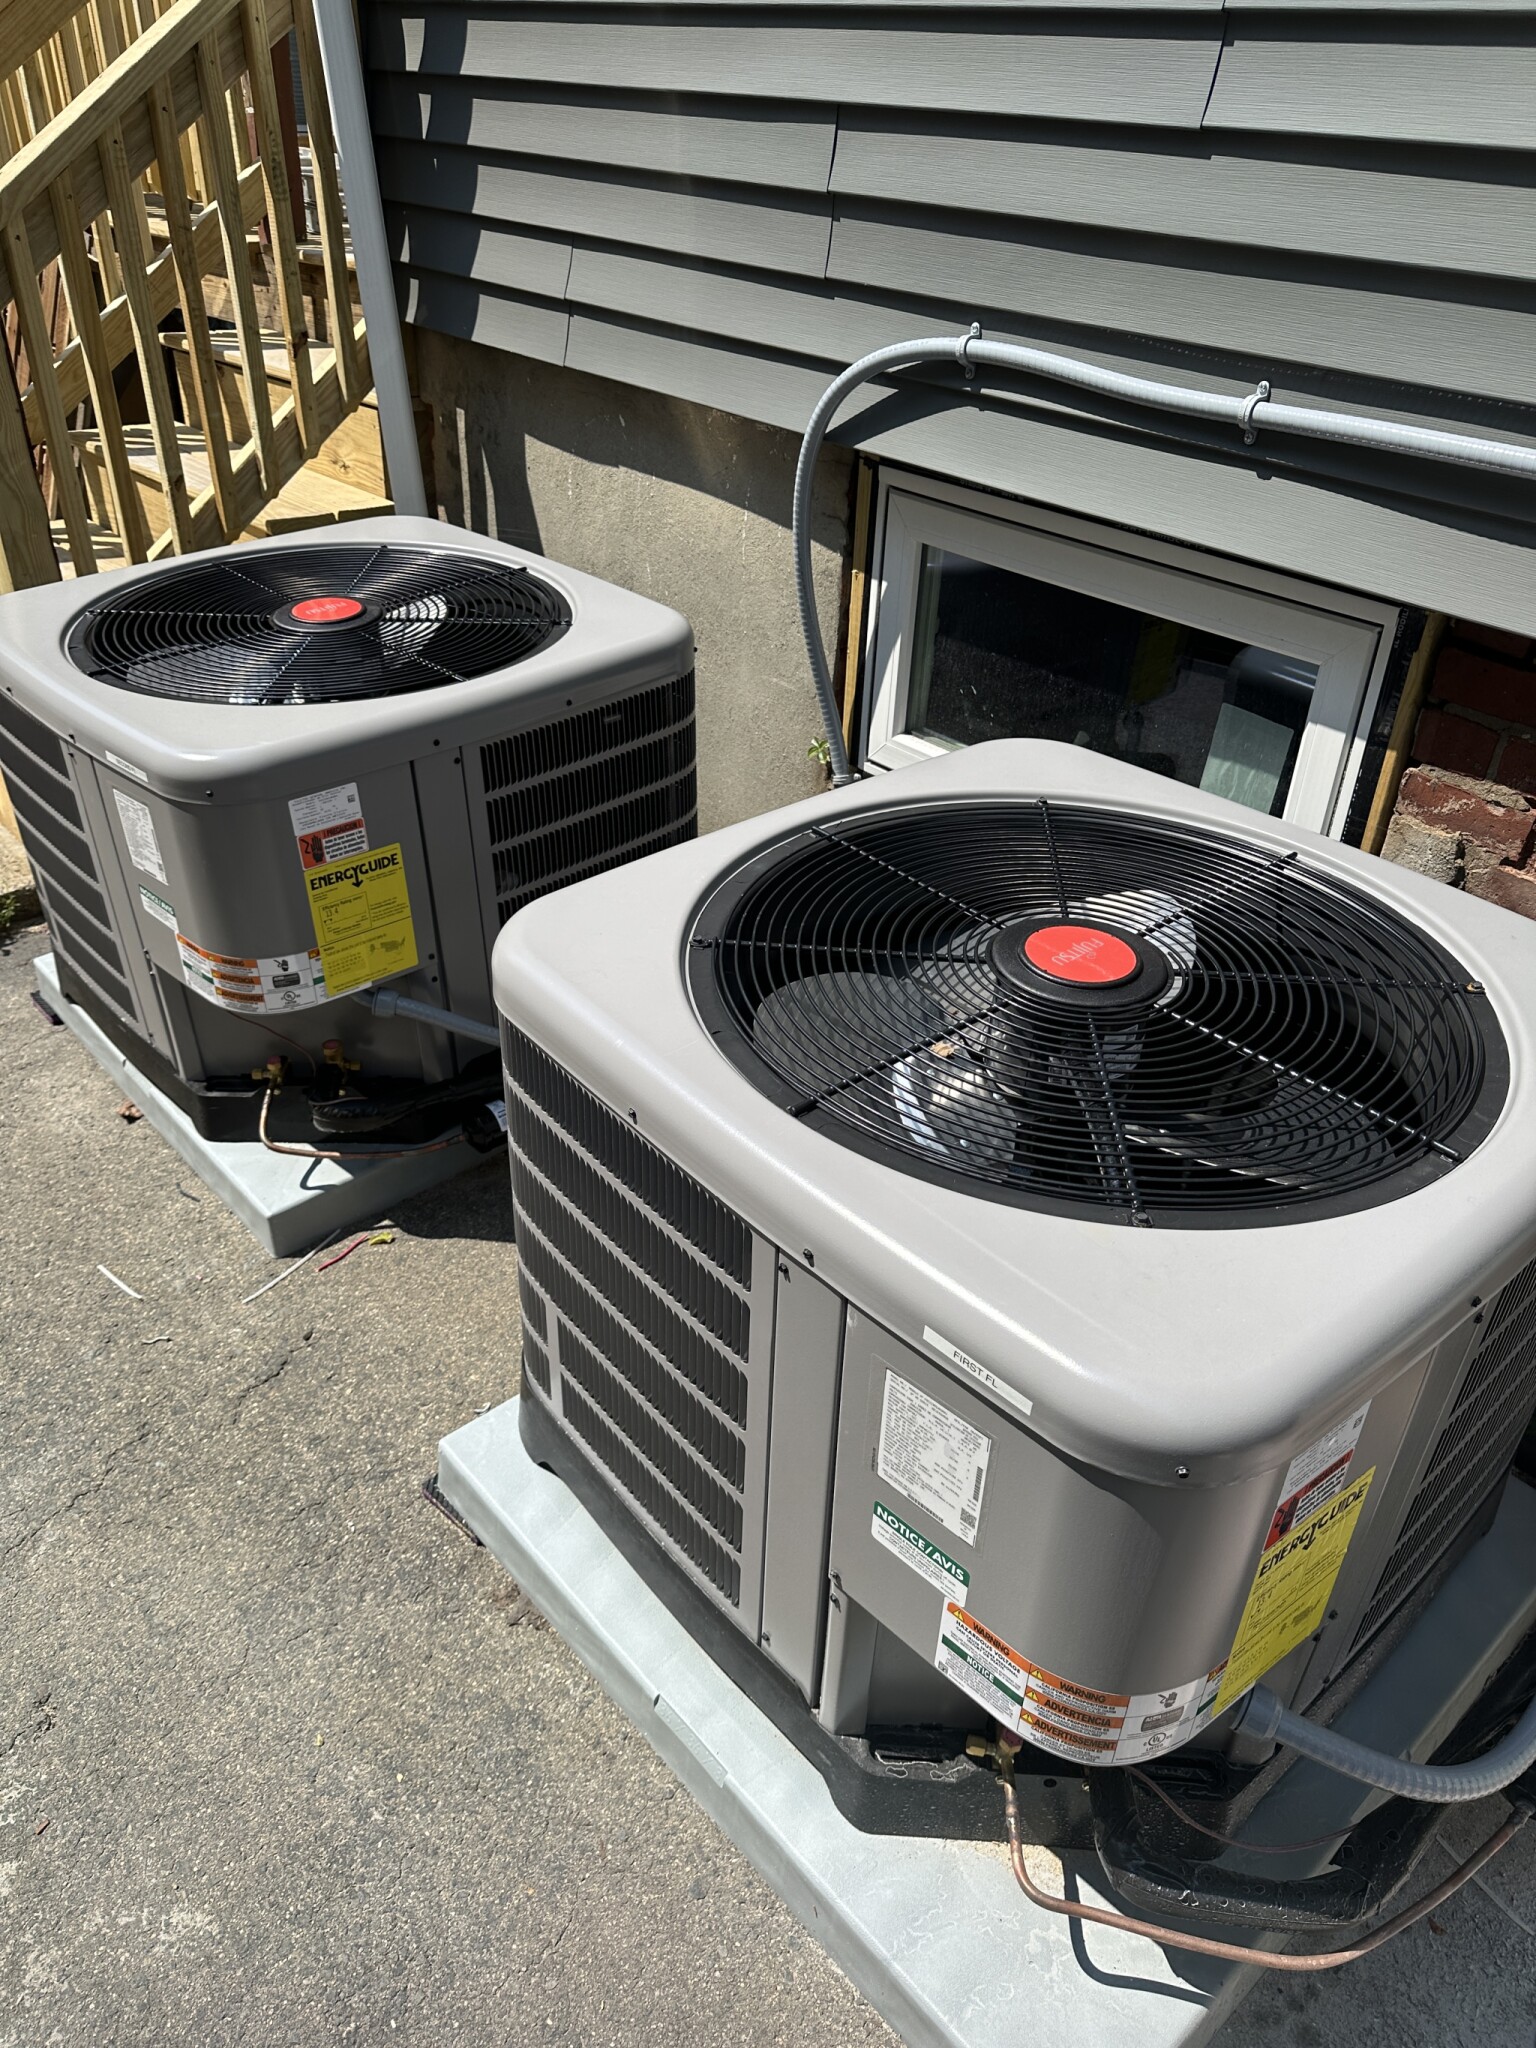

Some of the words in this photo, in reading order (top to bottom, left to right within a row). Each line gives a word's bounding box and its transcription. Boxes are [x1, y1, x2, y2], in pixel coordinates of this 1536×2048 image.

[309, 852, 400, 891] ENERGYGUIDE
[1052, 938, 1104, 966] FUJITSU
[953, 1350, 984, 1376] FIRST
[986, 1374, 998, 1389] FL
[1258, 1482, 1368, 1578] ENERGYGUIDE
[932, 1551, 964, 1581] AVIS
[956, 1619, 992, 1652] HAZARDOUS
[993, 1650, 1020, 1674] VOLTAGE
[973, 1622, 1010, 1656] WARNING
[966, 1656, 994, 1682] NOTICE
[1060, 1682, 1106, 1703] WARNING
[1044, 1700, 1110, 1726] ADVERTENCIA
[1033, 1719, 1115, 1750] ADVERTISSEMENT
